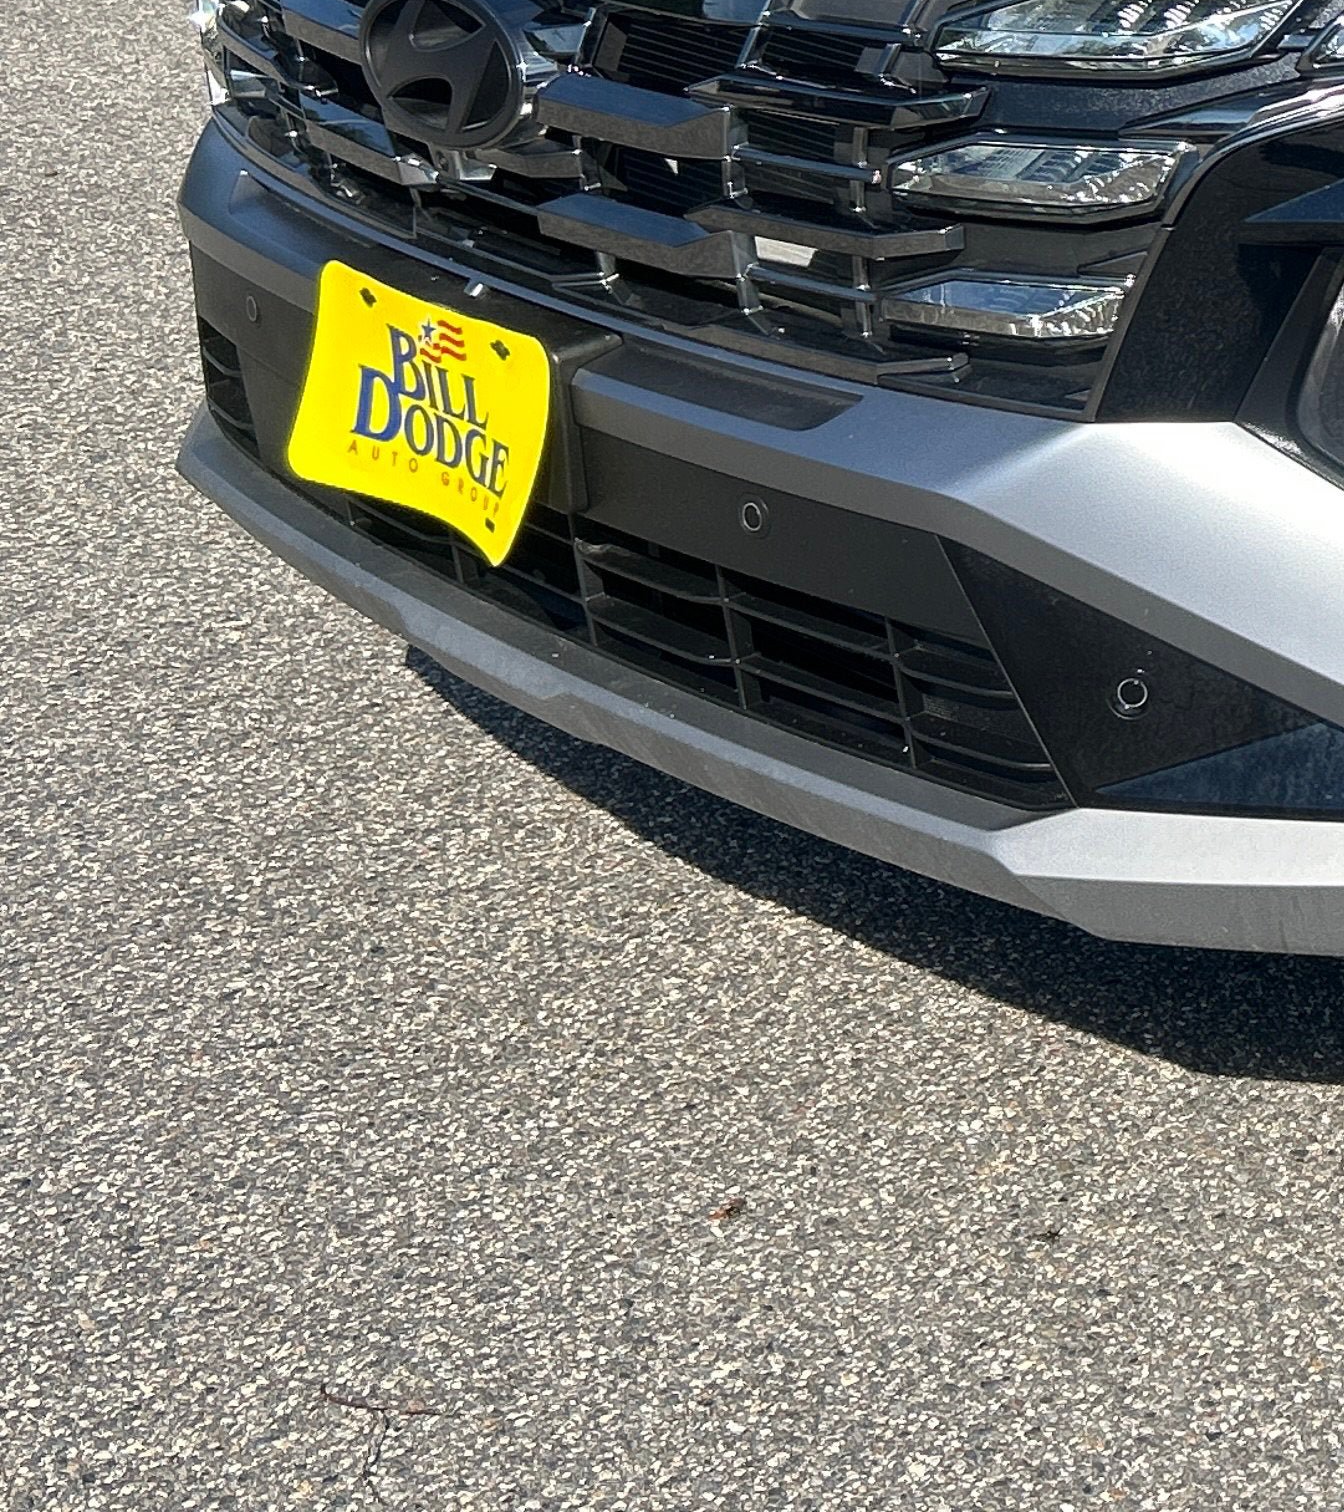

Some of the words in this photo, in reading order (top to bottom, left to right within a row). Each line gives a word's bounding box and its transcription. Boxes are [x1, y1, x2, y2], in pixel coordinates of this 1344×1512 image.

[386, 323, 490, 430] BILL
[347, 439, 419, 473] AUTO
[441, 471, 500, 518] GROUP
[350, 363, 510, 499] DODGE
